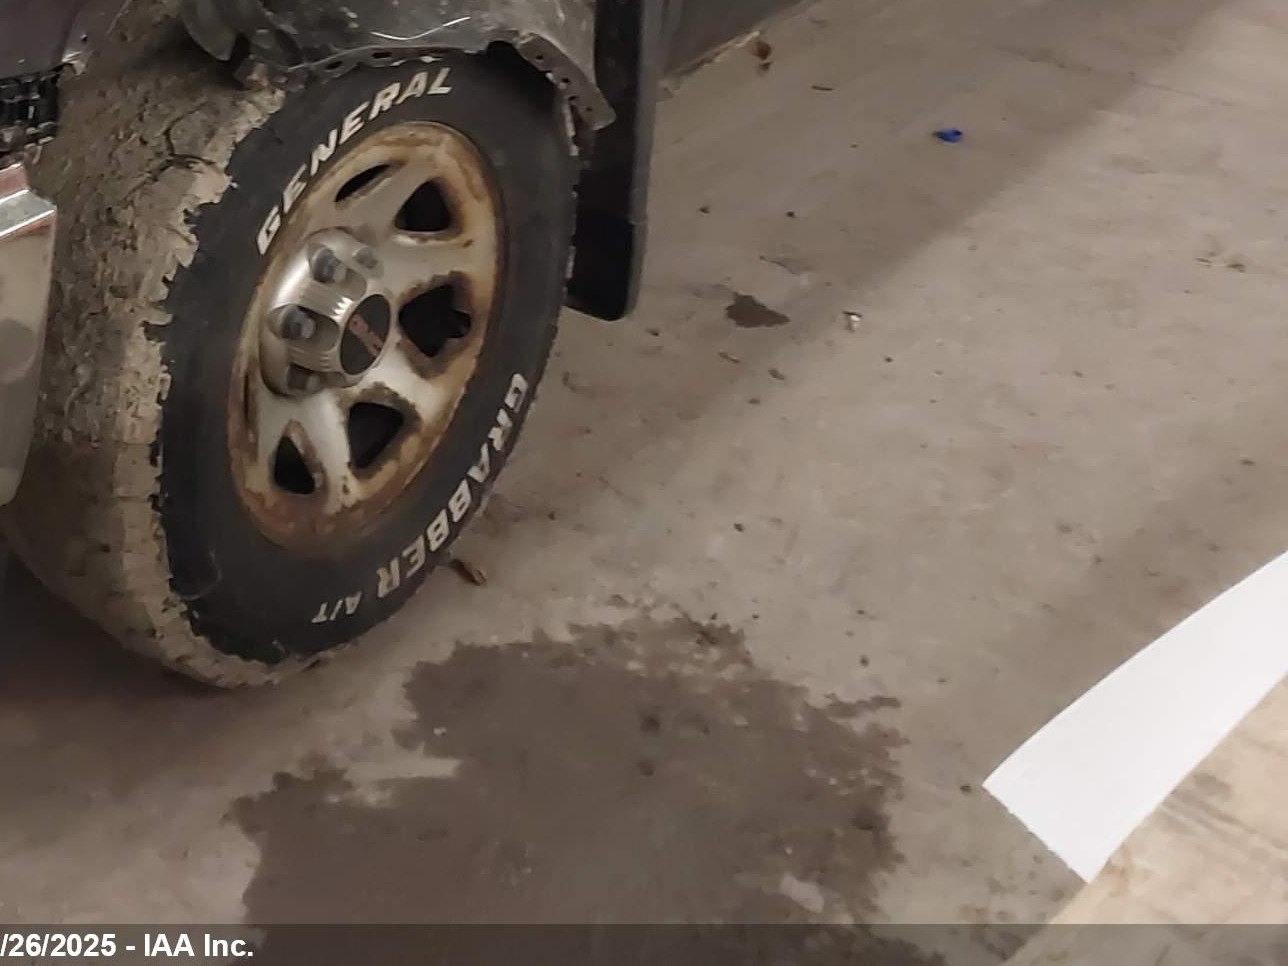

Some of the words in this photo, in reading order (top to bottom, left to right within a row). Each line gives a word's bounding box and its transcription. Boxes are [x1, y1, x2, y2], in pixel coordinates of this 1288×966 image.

[256, 67, 453, 255] GENERAL
[376, 373, 528, 598] GRABBER
[311, 590, 362, 623] A/T
